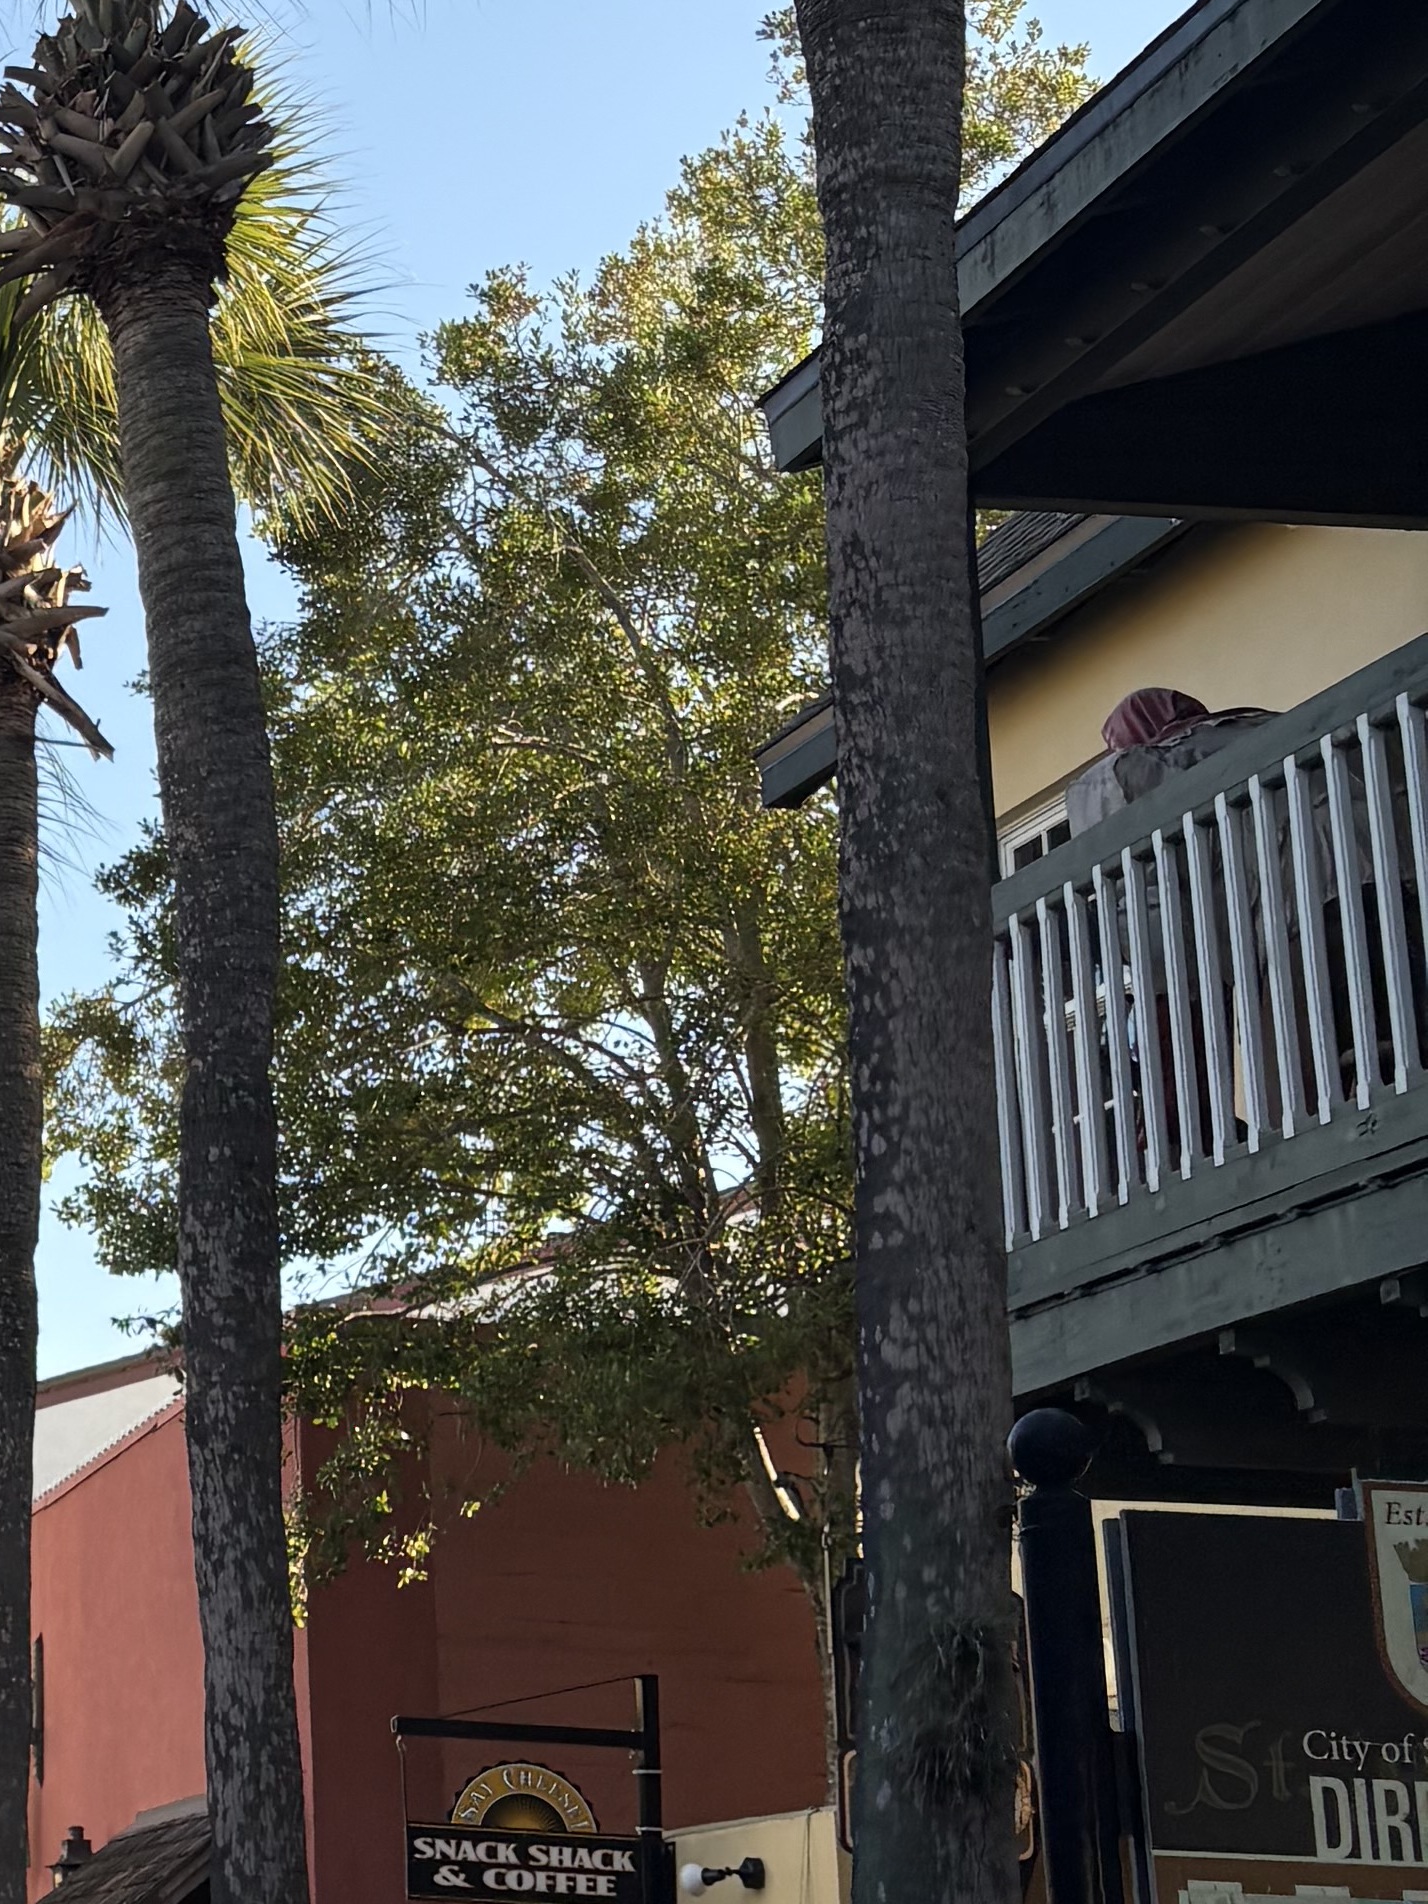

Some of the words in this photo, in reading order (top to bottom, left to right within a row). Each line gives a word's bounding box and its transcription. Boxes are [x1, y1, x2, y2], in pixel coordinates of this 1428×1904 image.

[1303, 1730, 1371, 1771] City
[1381, 1733, 1415, 1763] of
[413, 1837, 521, 1865] SNACK
[527, 1844, 636, 1872] SHACK
[433, 1865, 475, 1888] &
[482, 1868, 617, 1897] COFFEE
